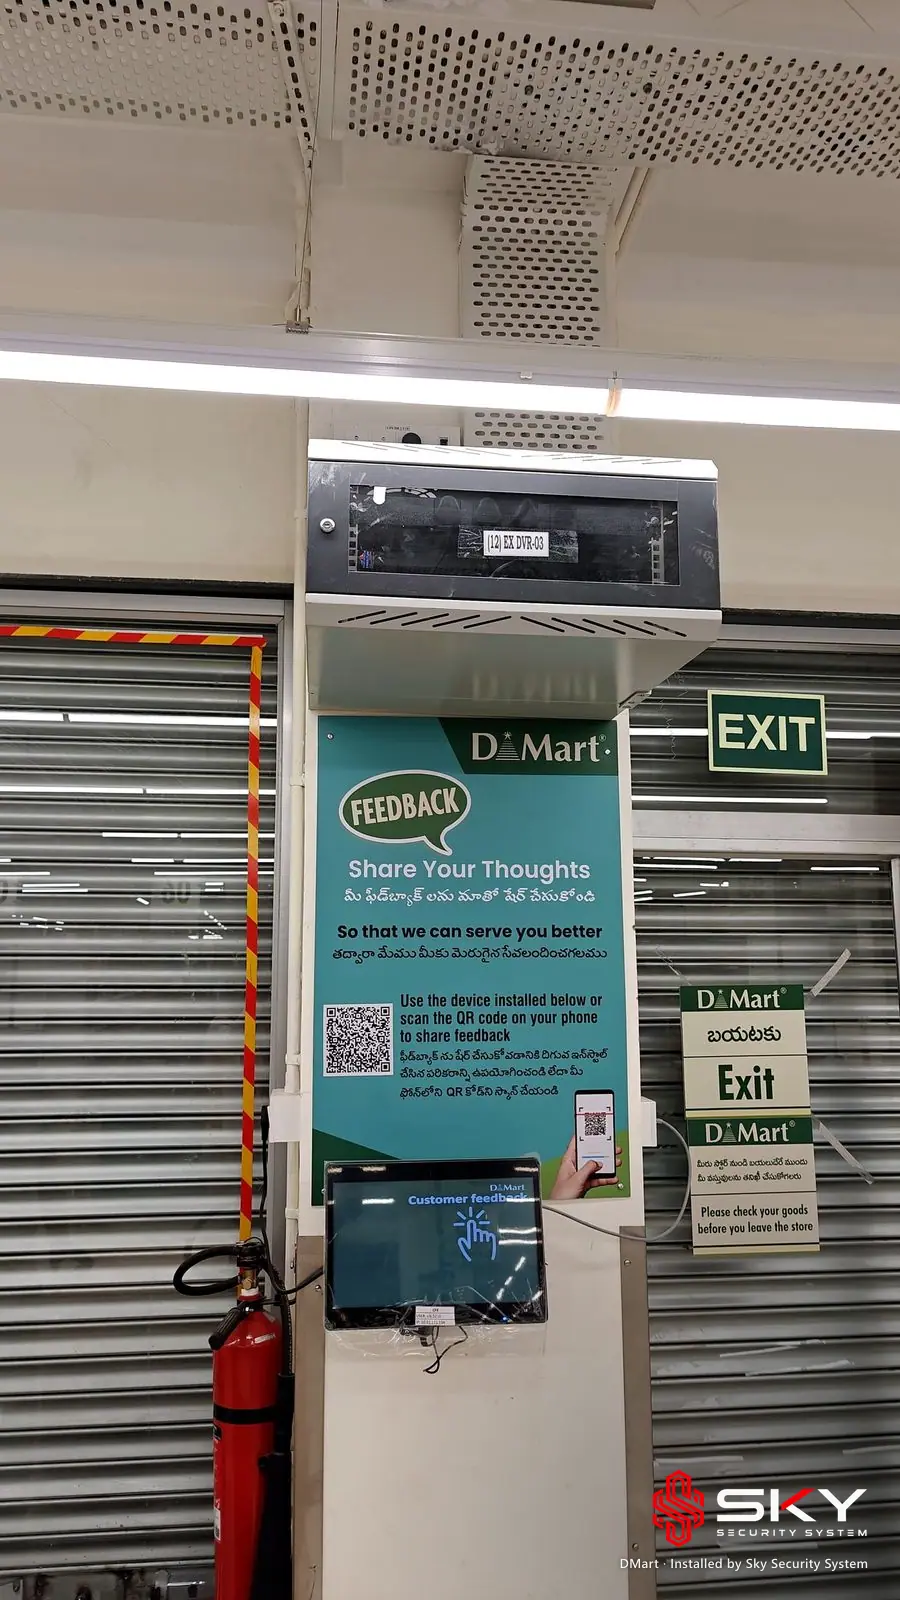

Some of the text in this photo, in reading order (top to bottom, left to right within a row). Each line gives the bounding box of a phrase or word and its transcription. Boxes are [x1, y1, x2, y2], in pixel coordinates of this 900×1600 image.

[488, 534, 544, 552] (12) EX DVR-03
[718, 713, 816, 752] EXIT
[350, 787, 460, 826] FEEDBACK
[349, 860, 590, 884] Share Your Thoughts
[344, 889, 361, 902] మీ
[426, 890, 454, 902] లను
[458, 888, 499, 902] మాతో
[503, 888, 528, 902] షేర్
[337, 924, 602, 942] So that we can serve you better
[332, 945, 608, 964] తద్వారా మేము మీకు మెరుగైన సేవలందించగలము
[400, 993, 602, 1007] Use the device installed below or
[400, 1011, 598, 1027] scan the QR code on your phone
[400, 1028, 510, 1043] to share feedback
[707, 1026, 782, 1043] బయటకు
[455, 1049, 470, 1061] షేర్
[542, 1050, 570, 1060] దిగువ
[400, 1067, 425, 1078] చేసిన
[548, 1066, 568, 1077] లేదా
[570, 1066, 583, 1076] మీ
[718, 1064, 774, 1101] Exit
[446, 1087, 462, 1097] QR
[520, 1085, 558, 1096] చేయండి
[408, 1195, 468, 1205] Customer
[701, 1204, 808, 1218] Please check your goods
[698, 1220, 814, 1236] before you leave the store
